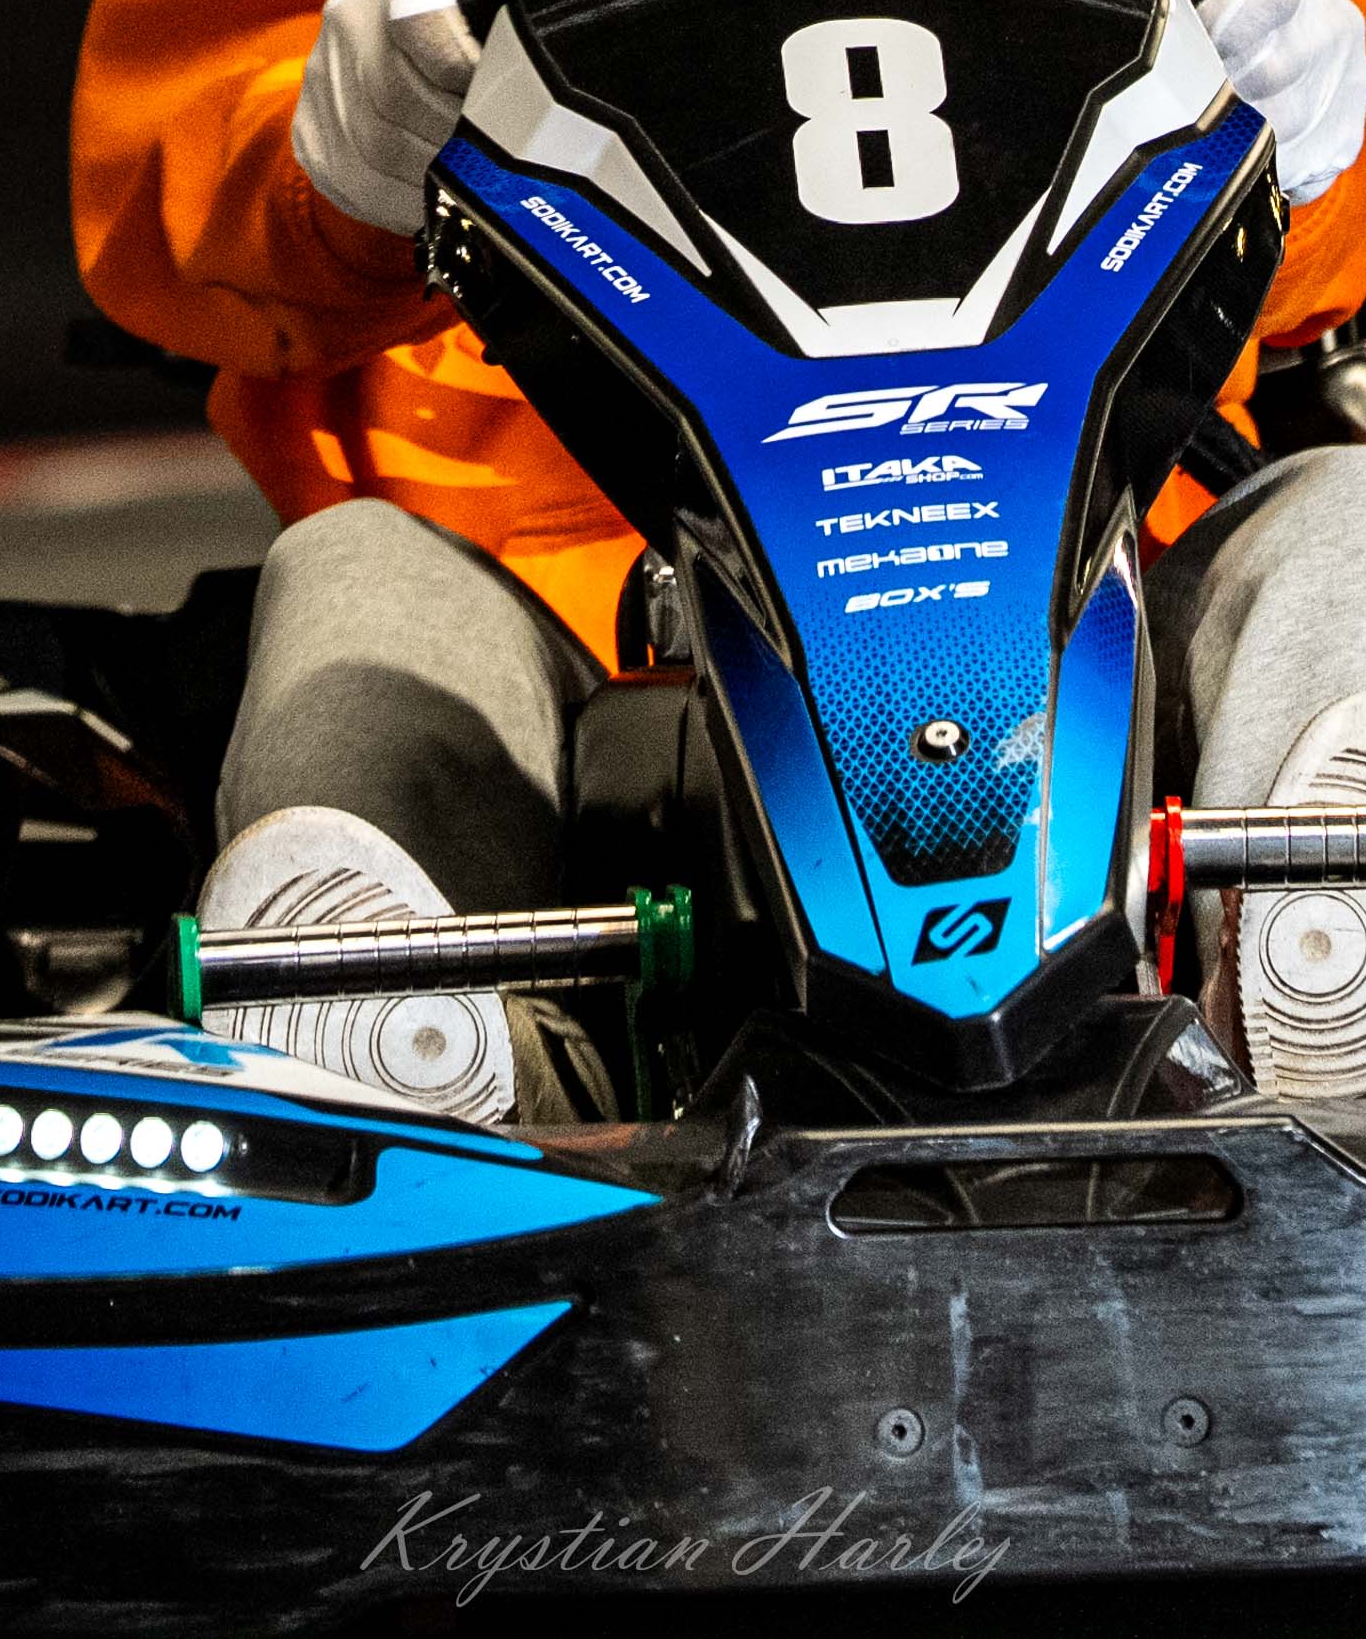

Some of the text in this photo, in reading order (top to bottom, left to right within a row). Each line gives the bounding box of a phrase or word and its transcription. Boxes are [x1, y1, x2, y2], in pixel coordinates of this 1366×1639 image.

[781, 17, 961, 225] 8
[1100, 161, 1203, 273] SODIKART.COM
[519, 195, 651, 304] SODIKART.COM
[760, 382, 1048, 444] SR
[898, 418, 1030, 435] SERIES
[821, 454, 983, 486] ITAKA
[815, 501, 1001, 537] TEKNEEX
[844, 580, 991, 614] BOX'S
